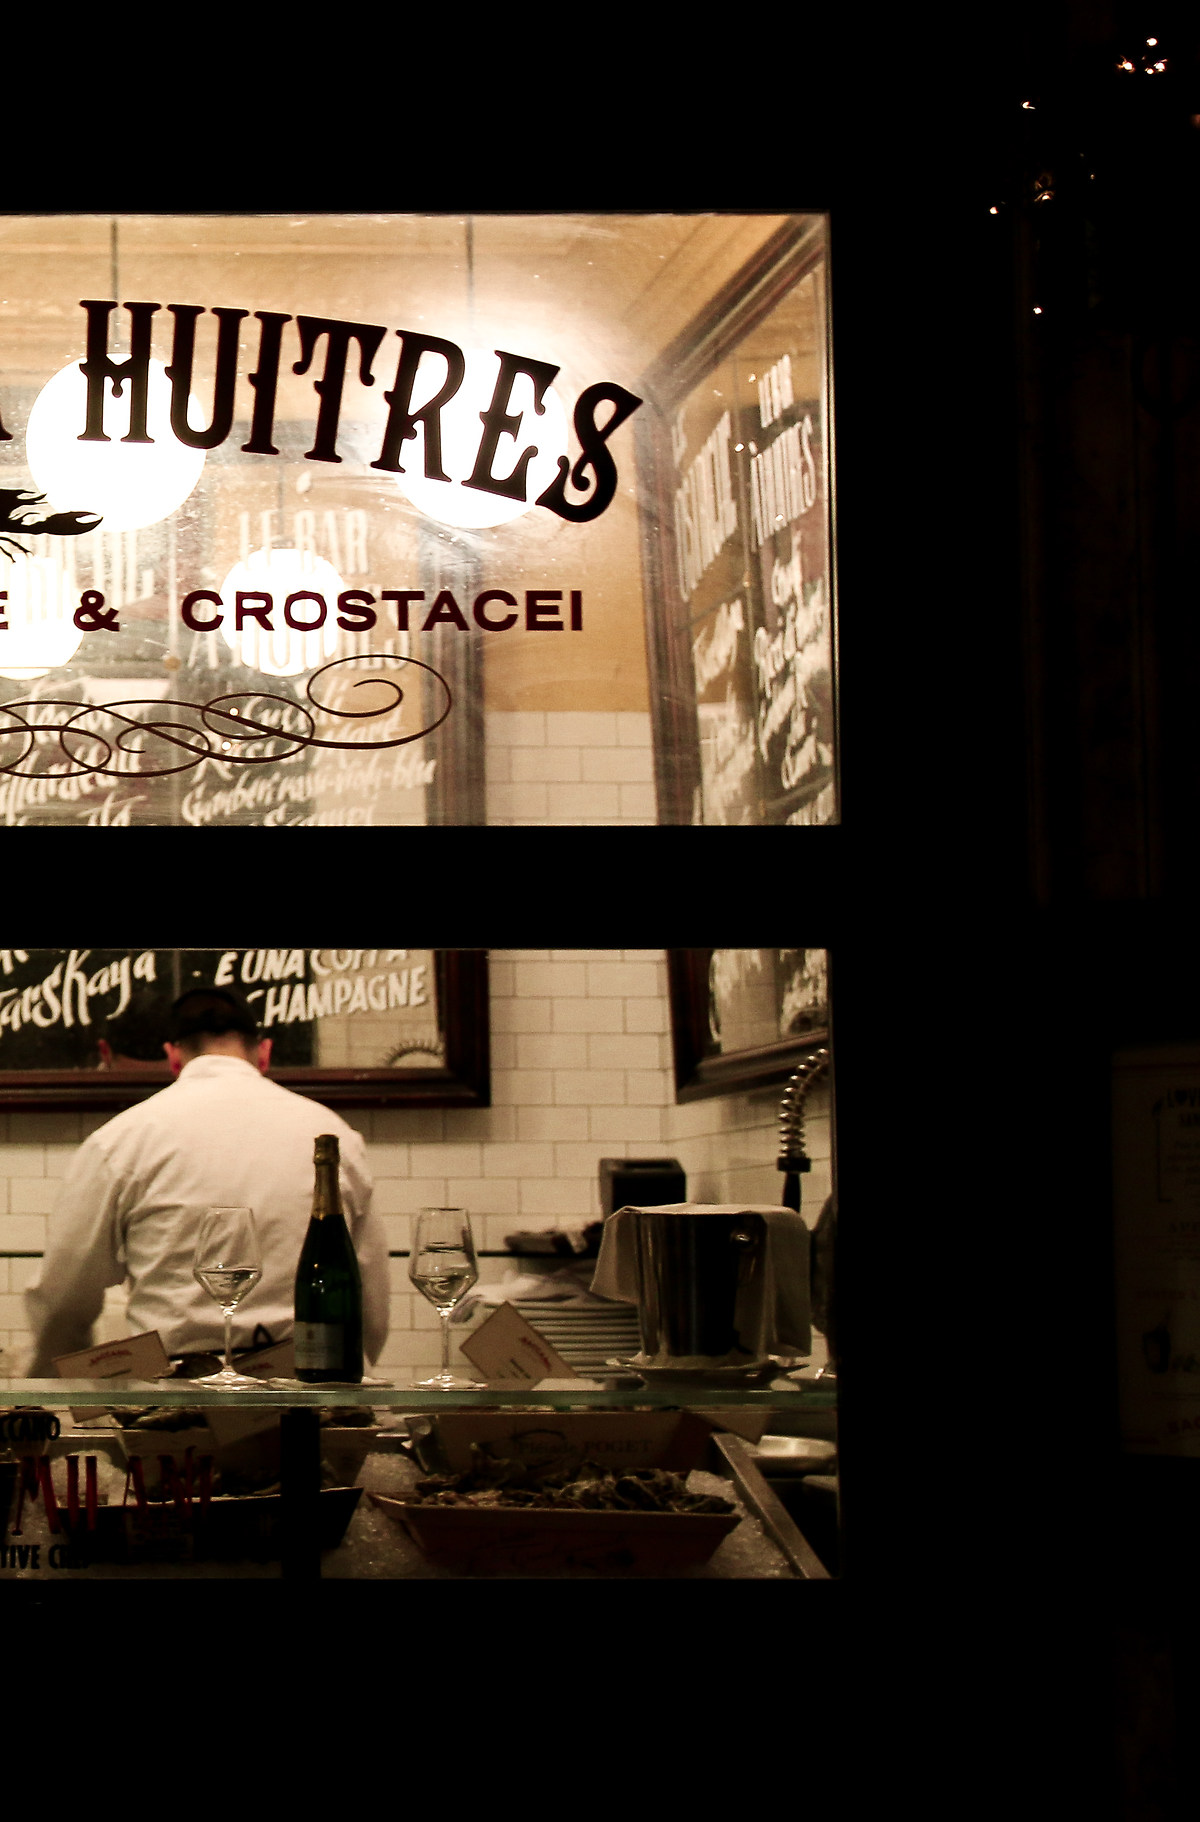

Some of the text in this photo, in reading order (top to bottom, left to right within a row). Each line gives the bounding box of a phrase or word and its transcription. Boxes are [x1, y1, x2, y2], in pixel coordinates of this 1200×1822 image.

[77, 300, 644, 524] HUITRES
[72, 589, 120, 632] &
[181, 589, 583, 632] CROSTACEI
[240, 950, 305, 984] UNA
